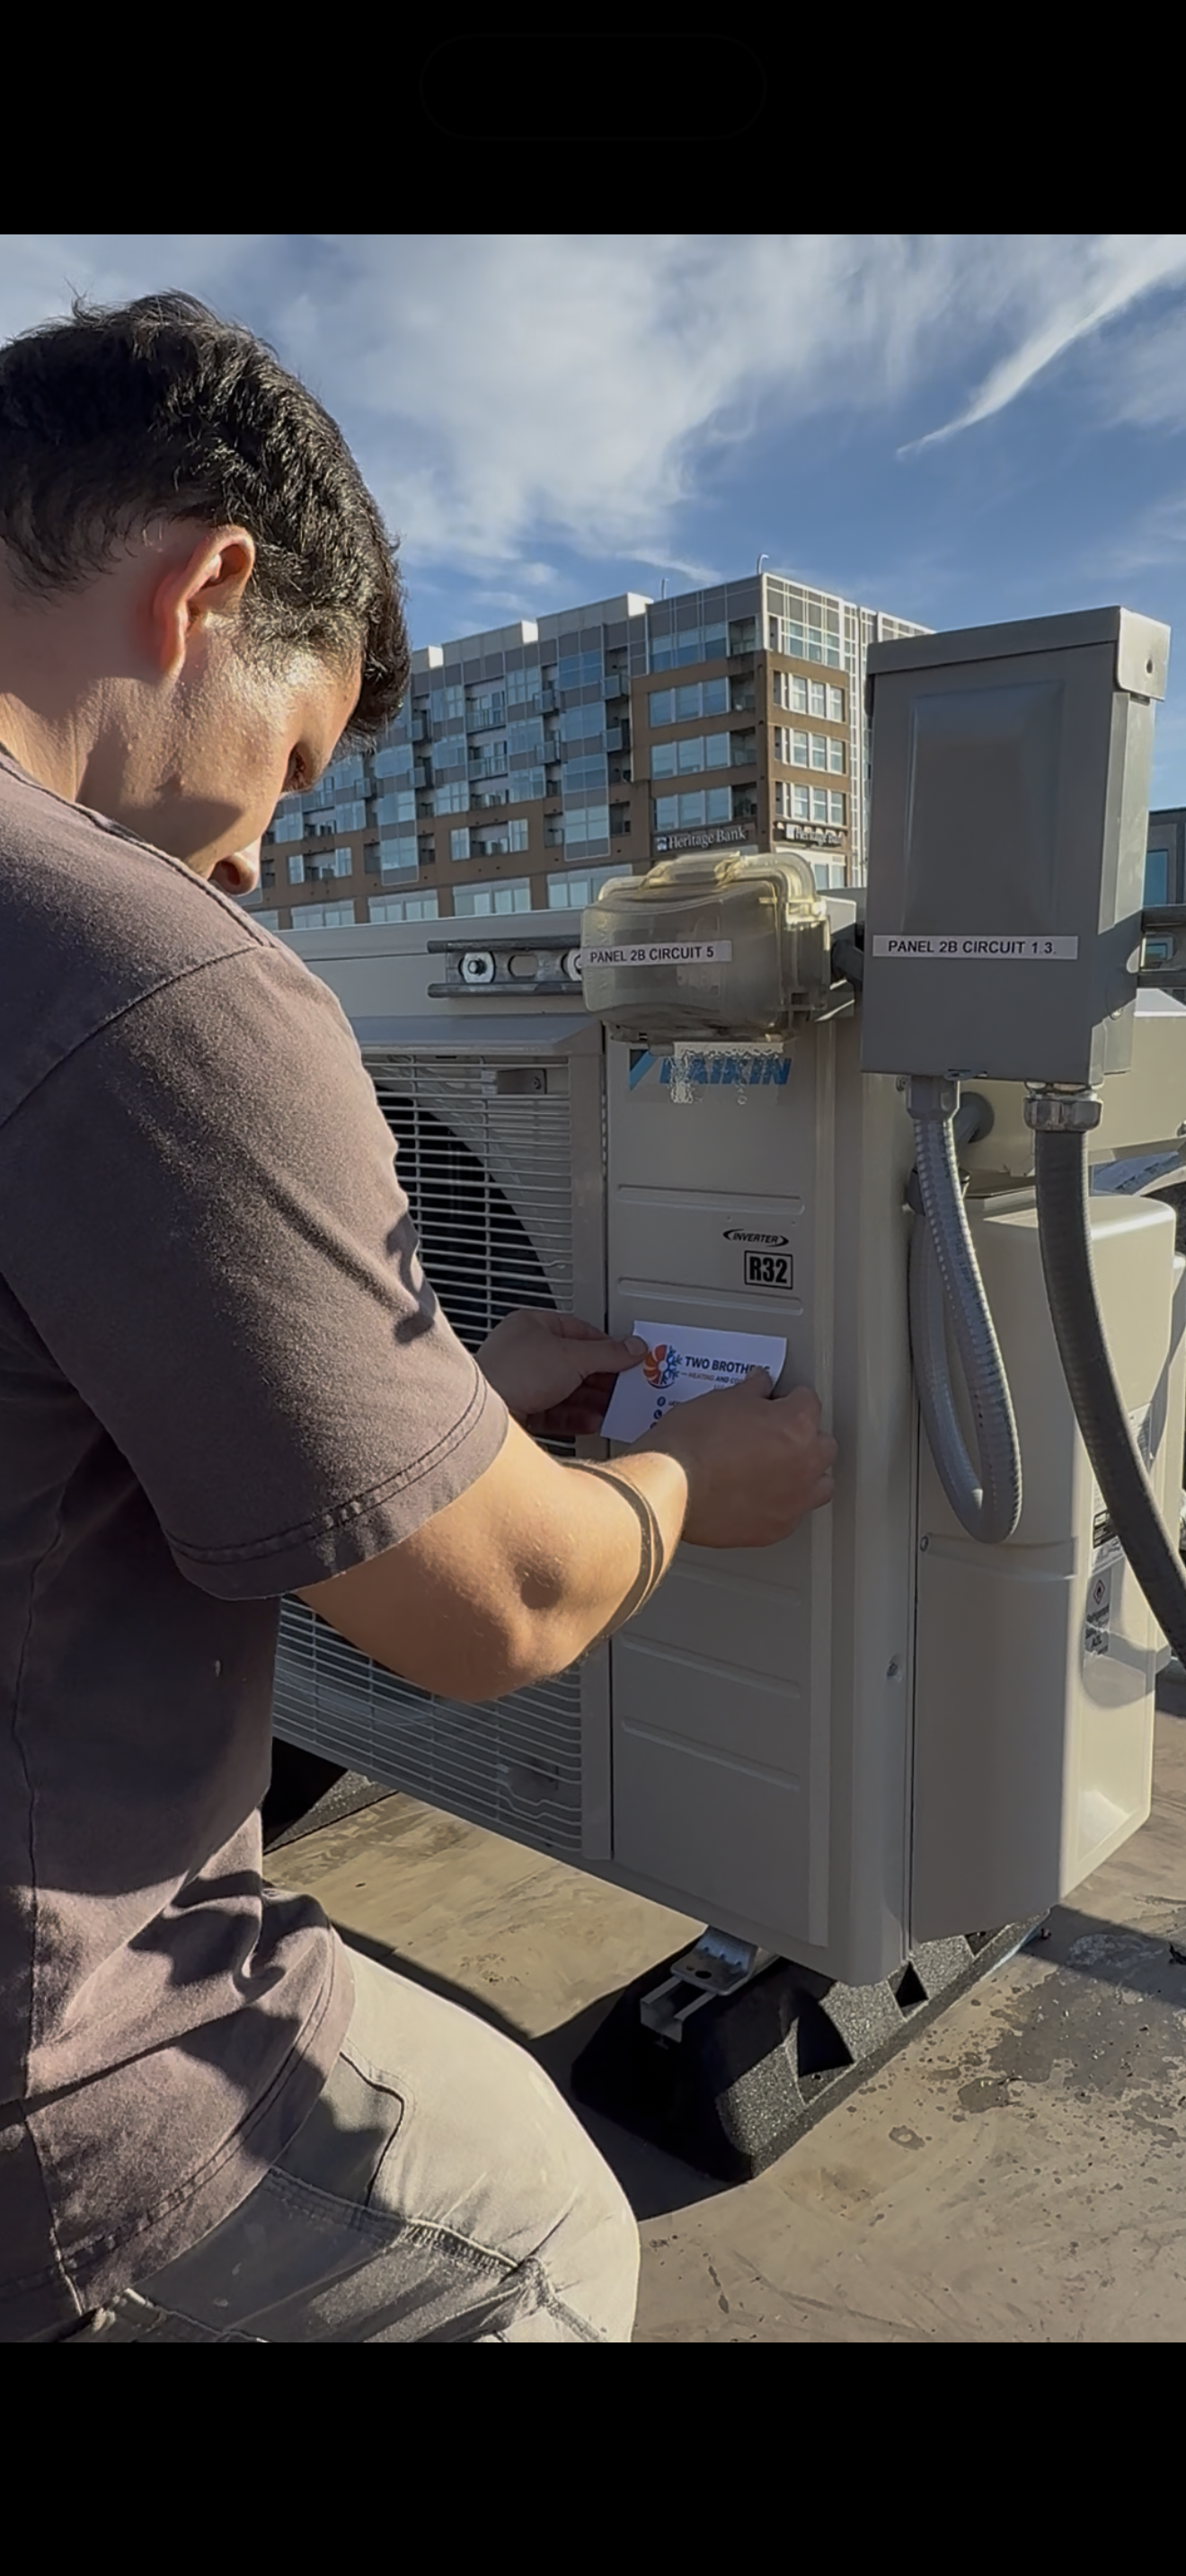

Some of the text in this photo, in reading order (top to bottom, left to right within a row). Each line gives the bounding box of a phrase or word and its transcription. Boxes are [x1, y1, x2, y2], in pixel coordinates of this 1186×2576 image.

[668, 827, 747, 850] Heritage Bank
[589, 945, 714, 963] PANEL 2B CIRCUIT 5
[888, 940, 934, 953] PANEL
[939, 940, 958, 954] 2B
[962, 940, 1026, 955] CIRCUIT
[732, 1231, 779, 1244] INVERTER
[749, 1256, 787, 1284] R32
[685, 1355, 710, 1370] TWO
[715, 1375, 730, 1383] AND
